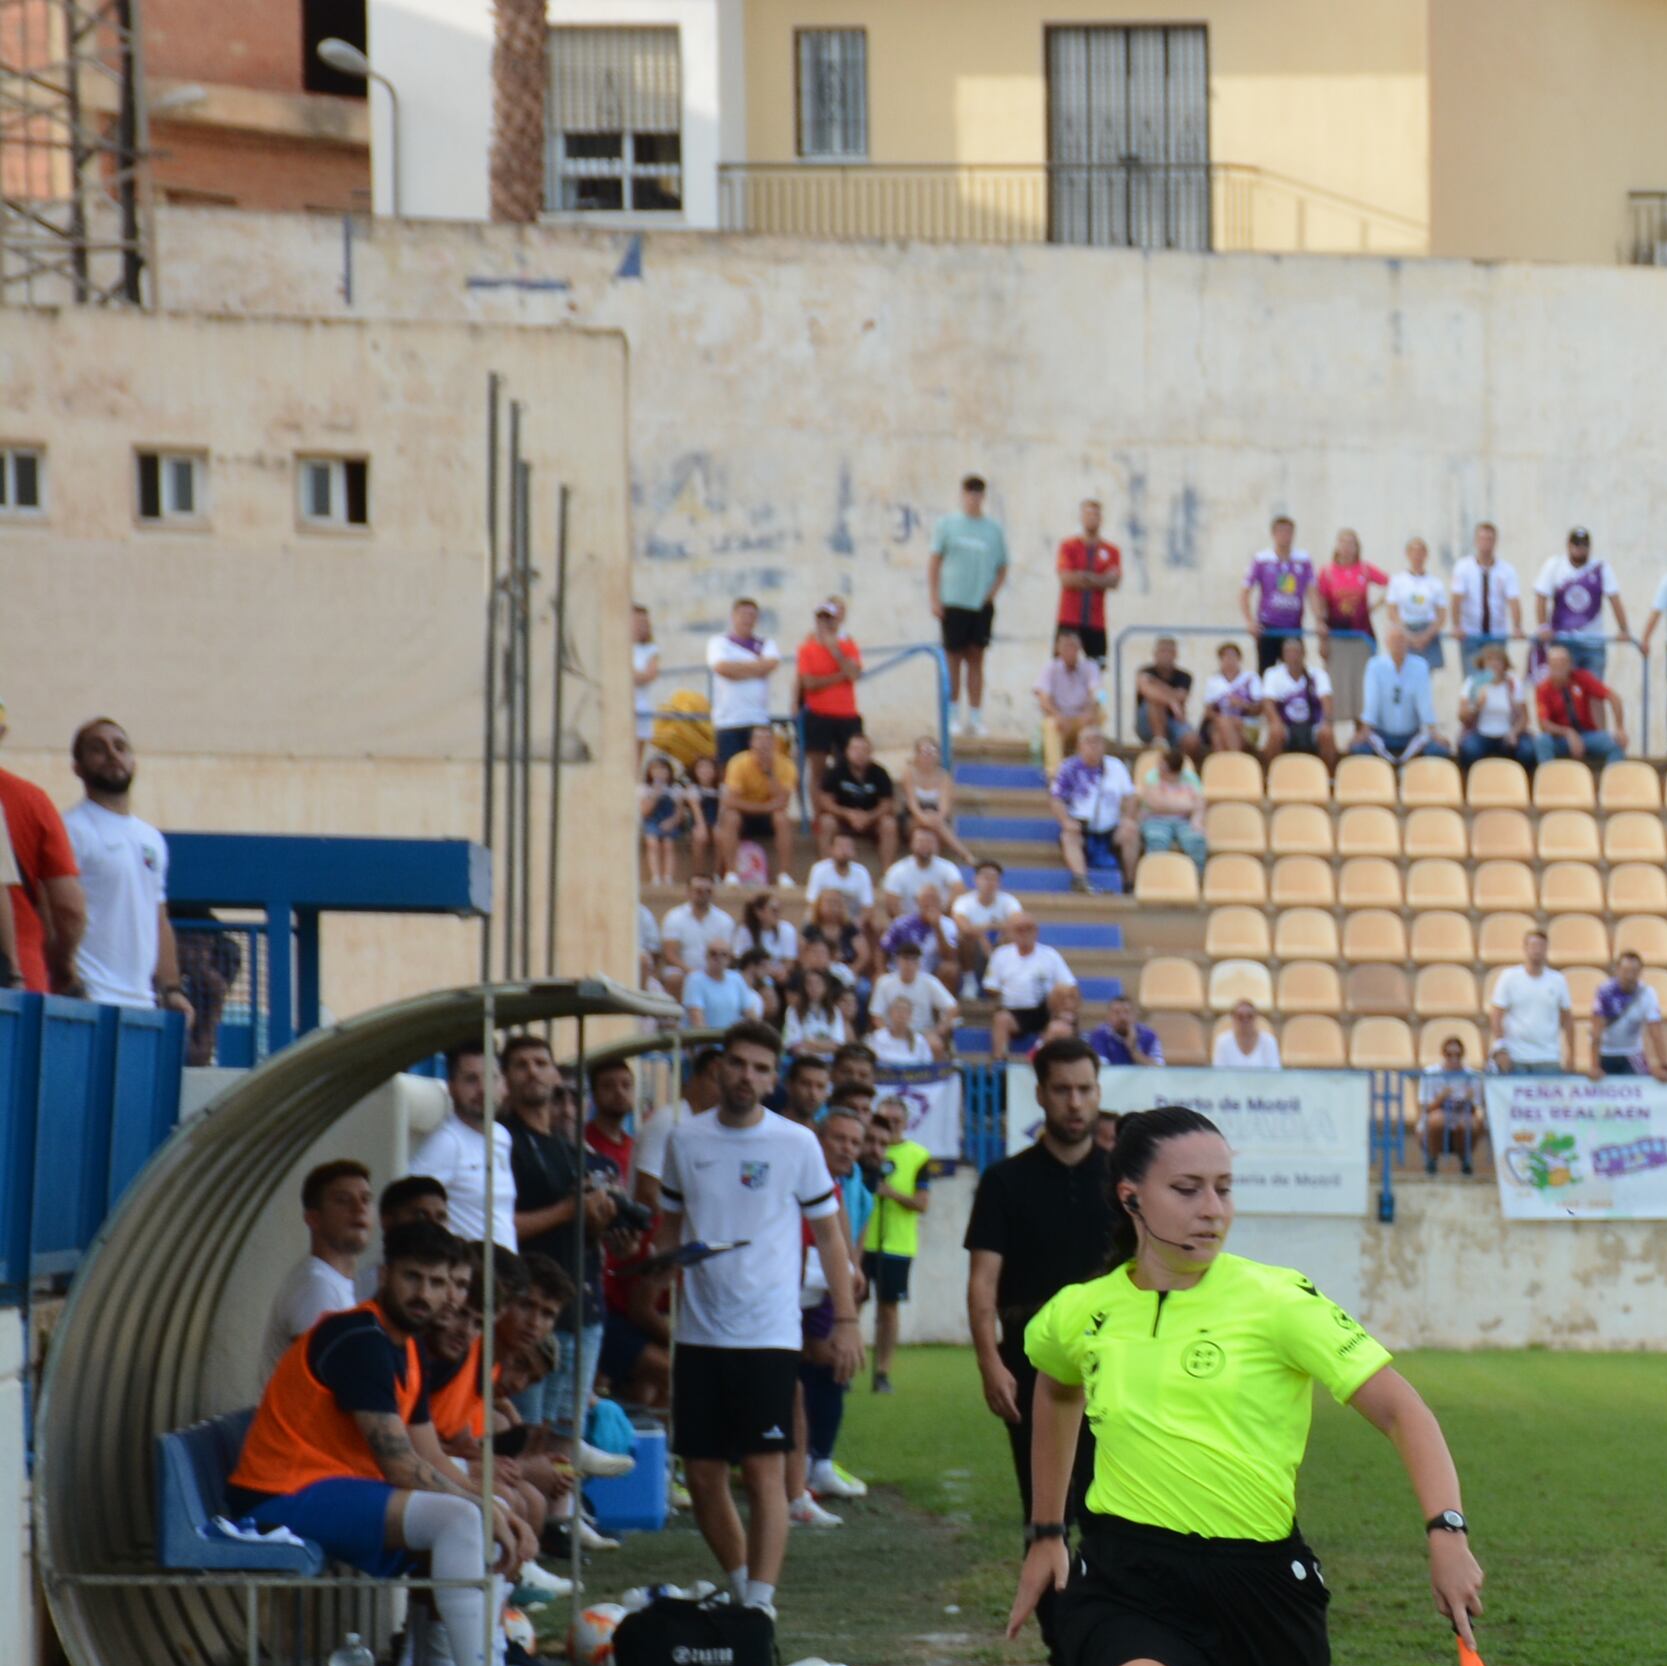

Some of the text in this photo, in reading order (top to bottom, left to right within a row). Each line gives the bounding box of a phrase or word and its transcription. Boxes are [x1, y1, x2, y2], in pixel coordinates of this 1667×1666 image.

[1570, 1085, 1643, 1099] AMIGOS
[1511, 1105, 1541, 1119] DEL
[1550, 1106, 1595, 1119] REAL
